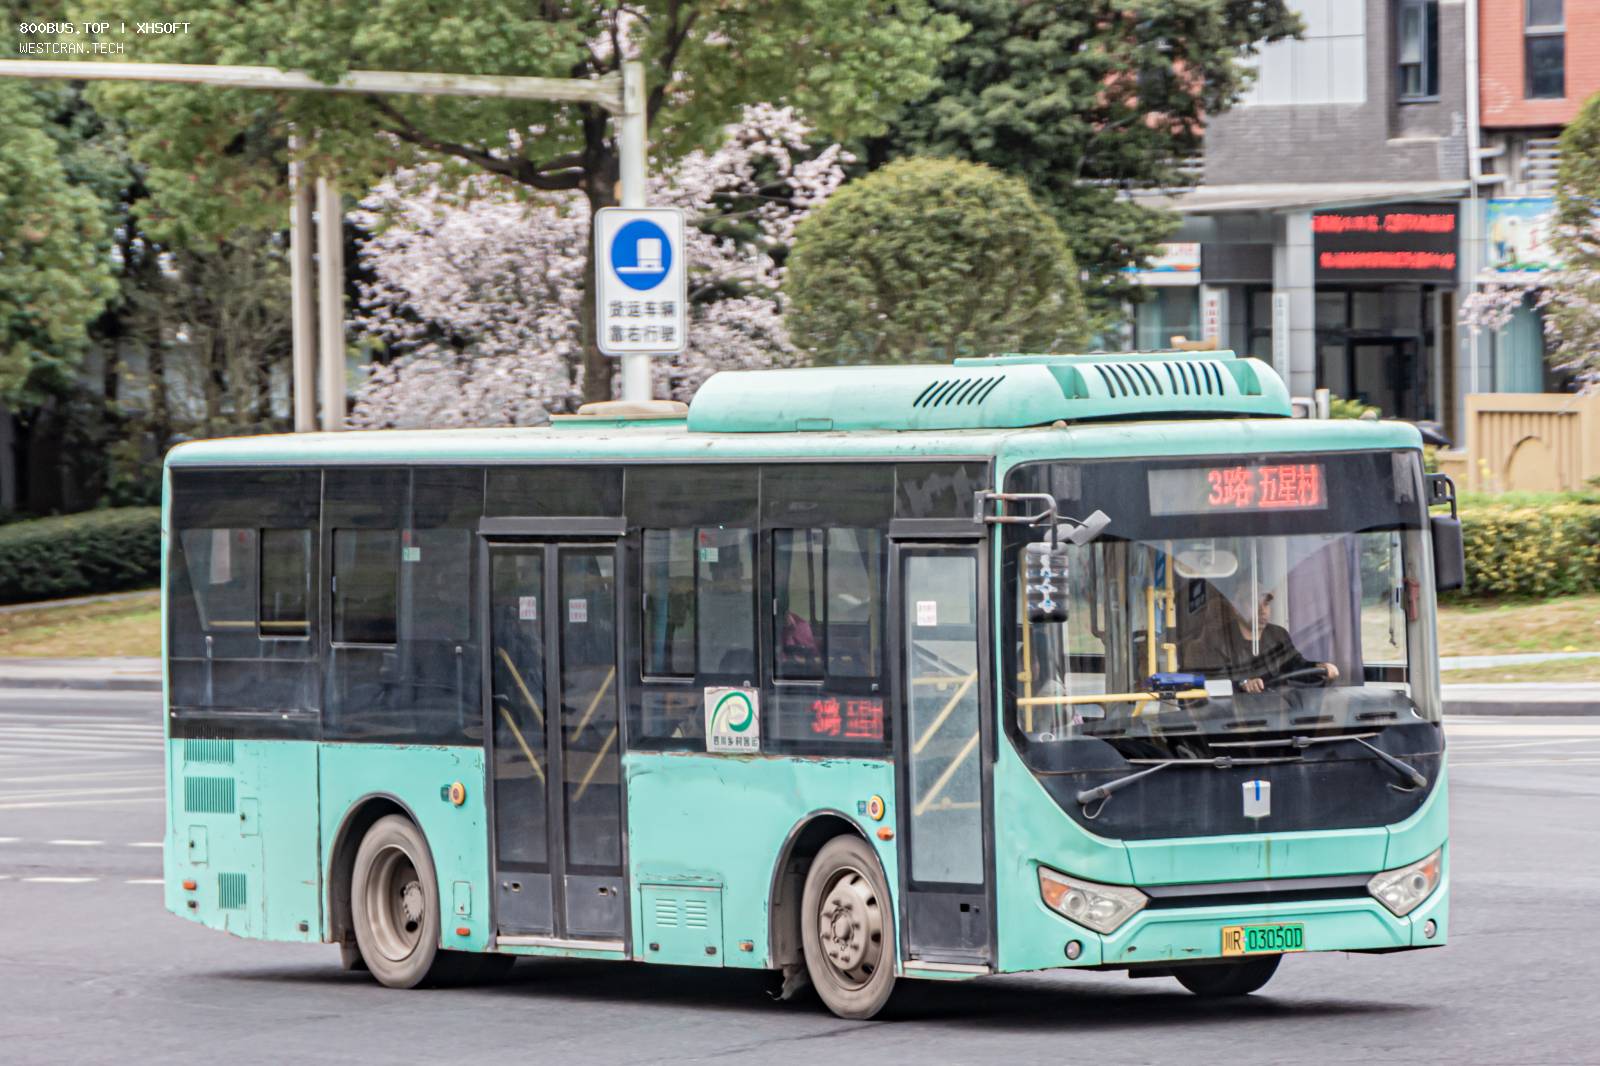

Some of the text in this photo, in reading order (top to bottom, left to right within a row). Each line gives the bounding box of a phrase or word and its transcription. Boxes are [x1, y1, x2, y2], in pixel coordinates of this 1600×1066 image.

[608, 324, 676, 343] 靠右行驶
[1207, 463, 1321, 508] 3路 五星村
